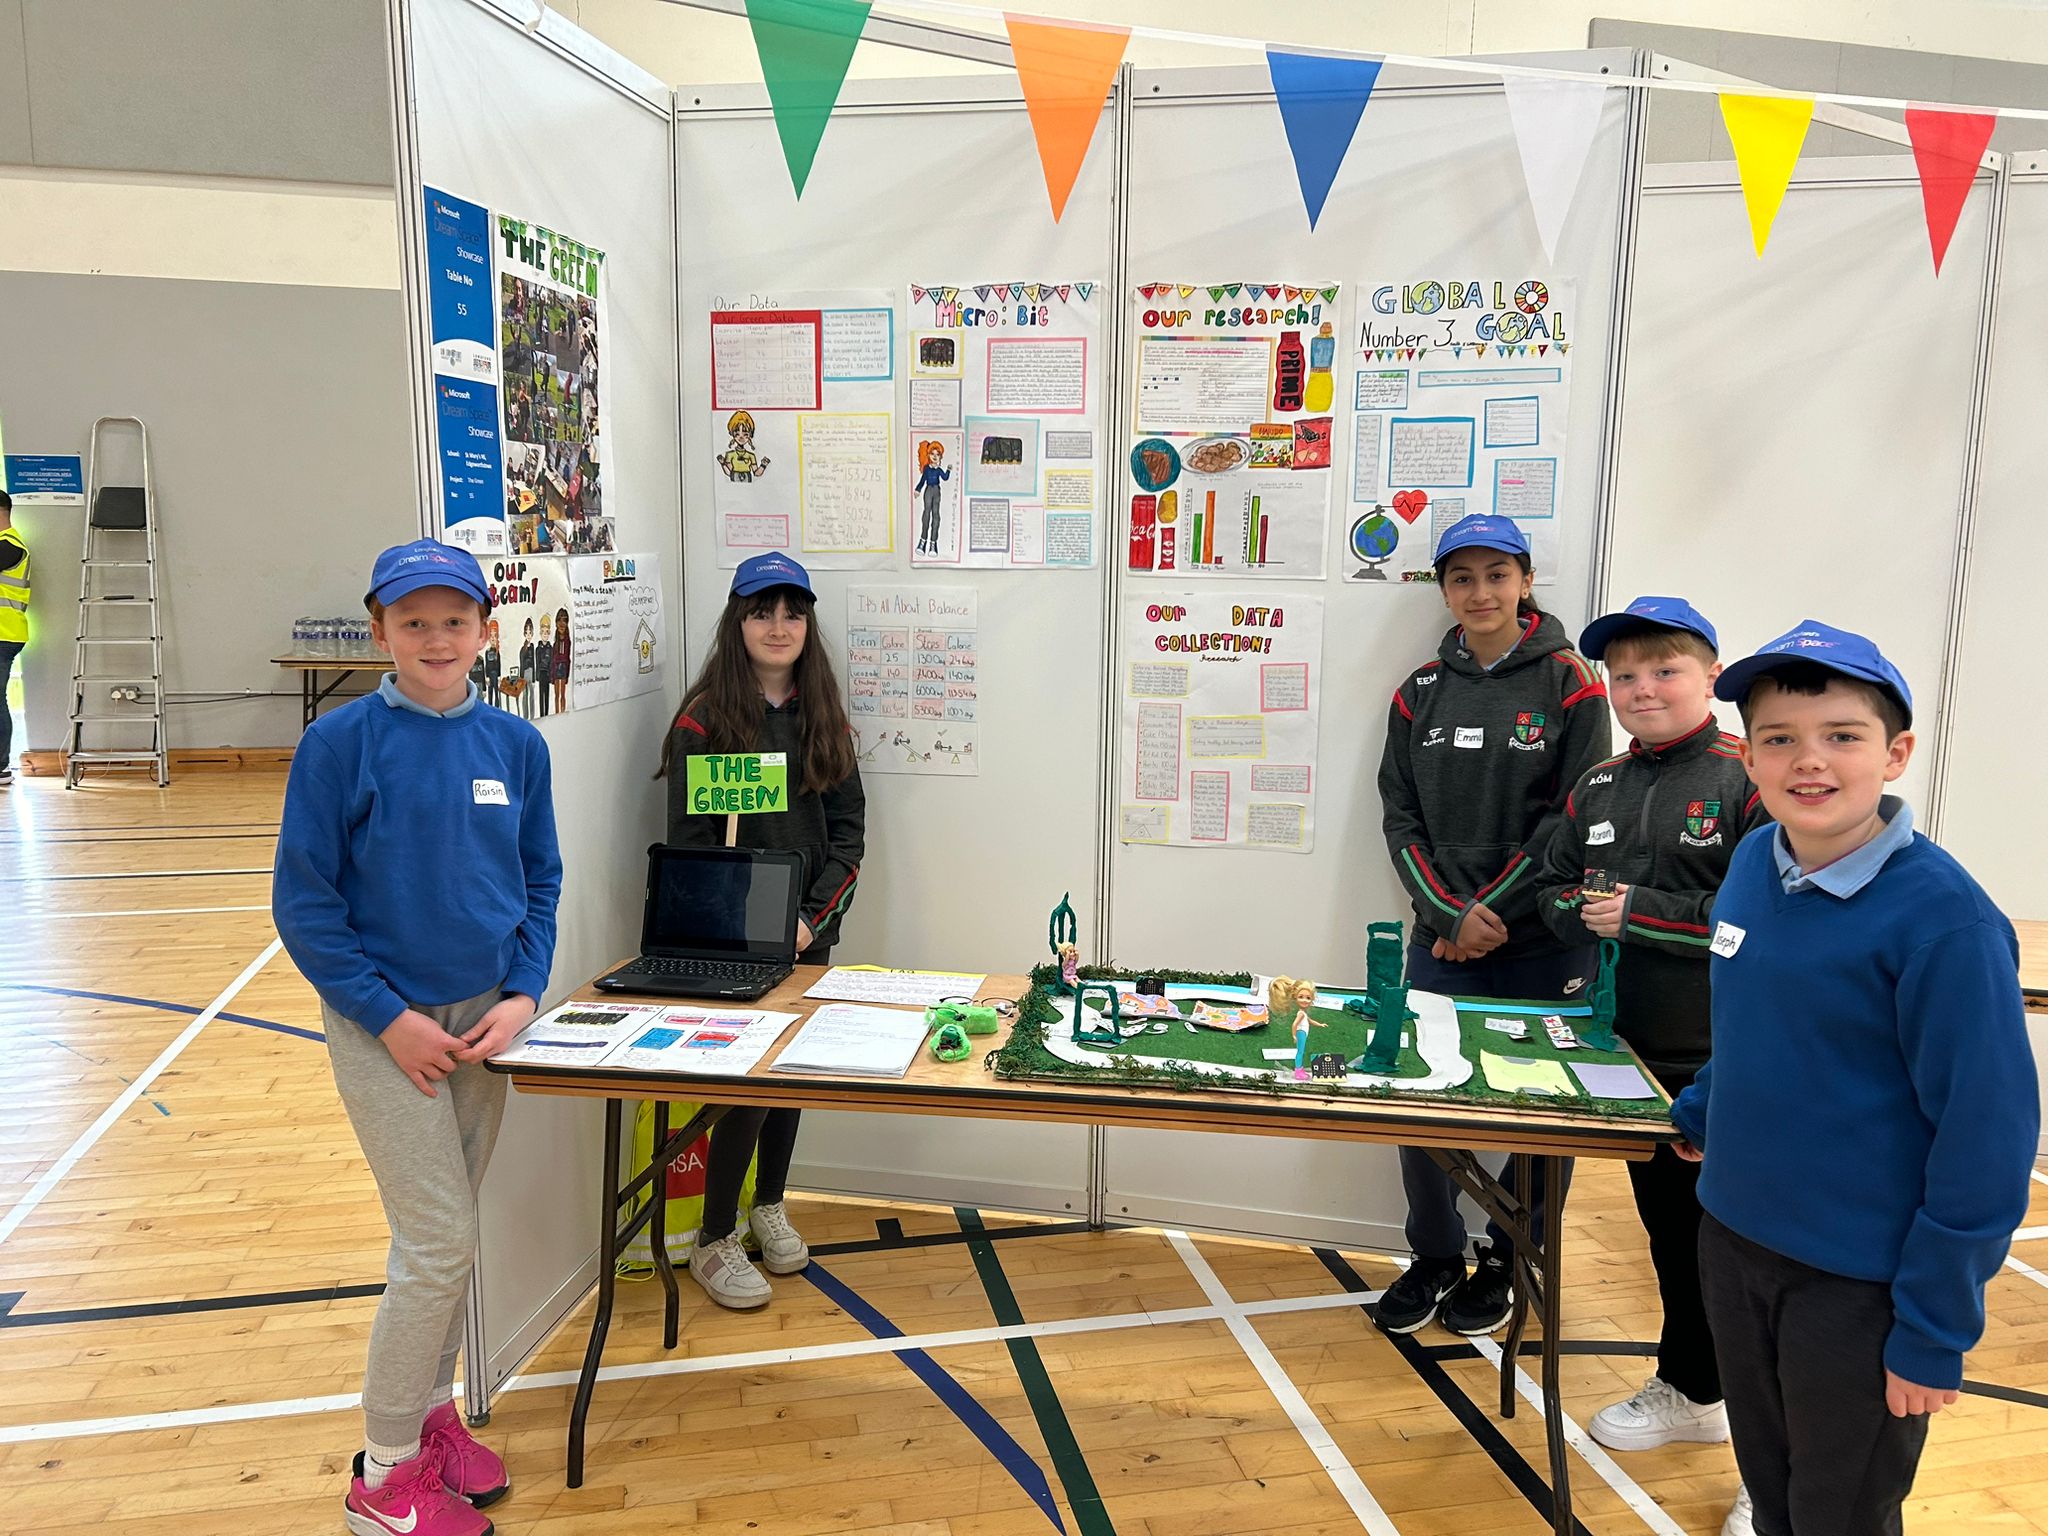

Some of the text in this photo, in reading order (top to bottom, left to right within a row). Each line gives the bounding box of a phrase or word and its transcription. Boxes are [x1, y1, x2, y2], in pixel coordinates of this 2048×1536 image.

[441, 204, 461, 220] Microsoft
[456, 246, 484, 264] Showcase
[501, 227, 597, 299] THE GREEN
[446, 268, 473, 287] Table No
[457, 302, 468, 316] 55
[714, 293, 779, 310] Our Data
[1017, 304, 1049, 327] Bit
[1204, 304, 1322, 328] research!
[1360, 319, 1456, 348] Number 3
[1280, 350, 1301, 408] PRIME
[448, 388, 471, 400] Microsoft
[467, 425, 494, 440] Showcase
[398, 554, 429, 566] Dream
[603, 559, 636, 578] PLAN
[488, 578, 539, 608] team!
[894, 594, 920, 615] About
[929, 598, 969, 616] Balance
[1232, 605, 1284, 628] DATA
[851, 633, 876, 647] Item
[1155, 632, 1273, 655] COLLECTION!
[885, 652, 899, 663] 25
[1416, 672, 1438, 686] EEM
[705, 756, 762, 783] THE
[694, 785, 780, 813] GREEN
